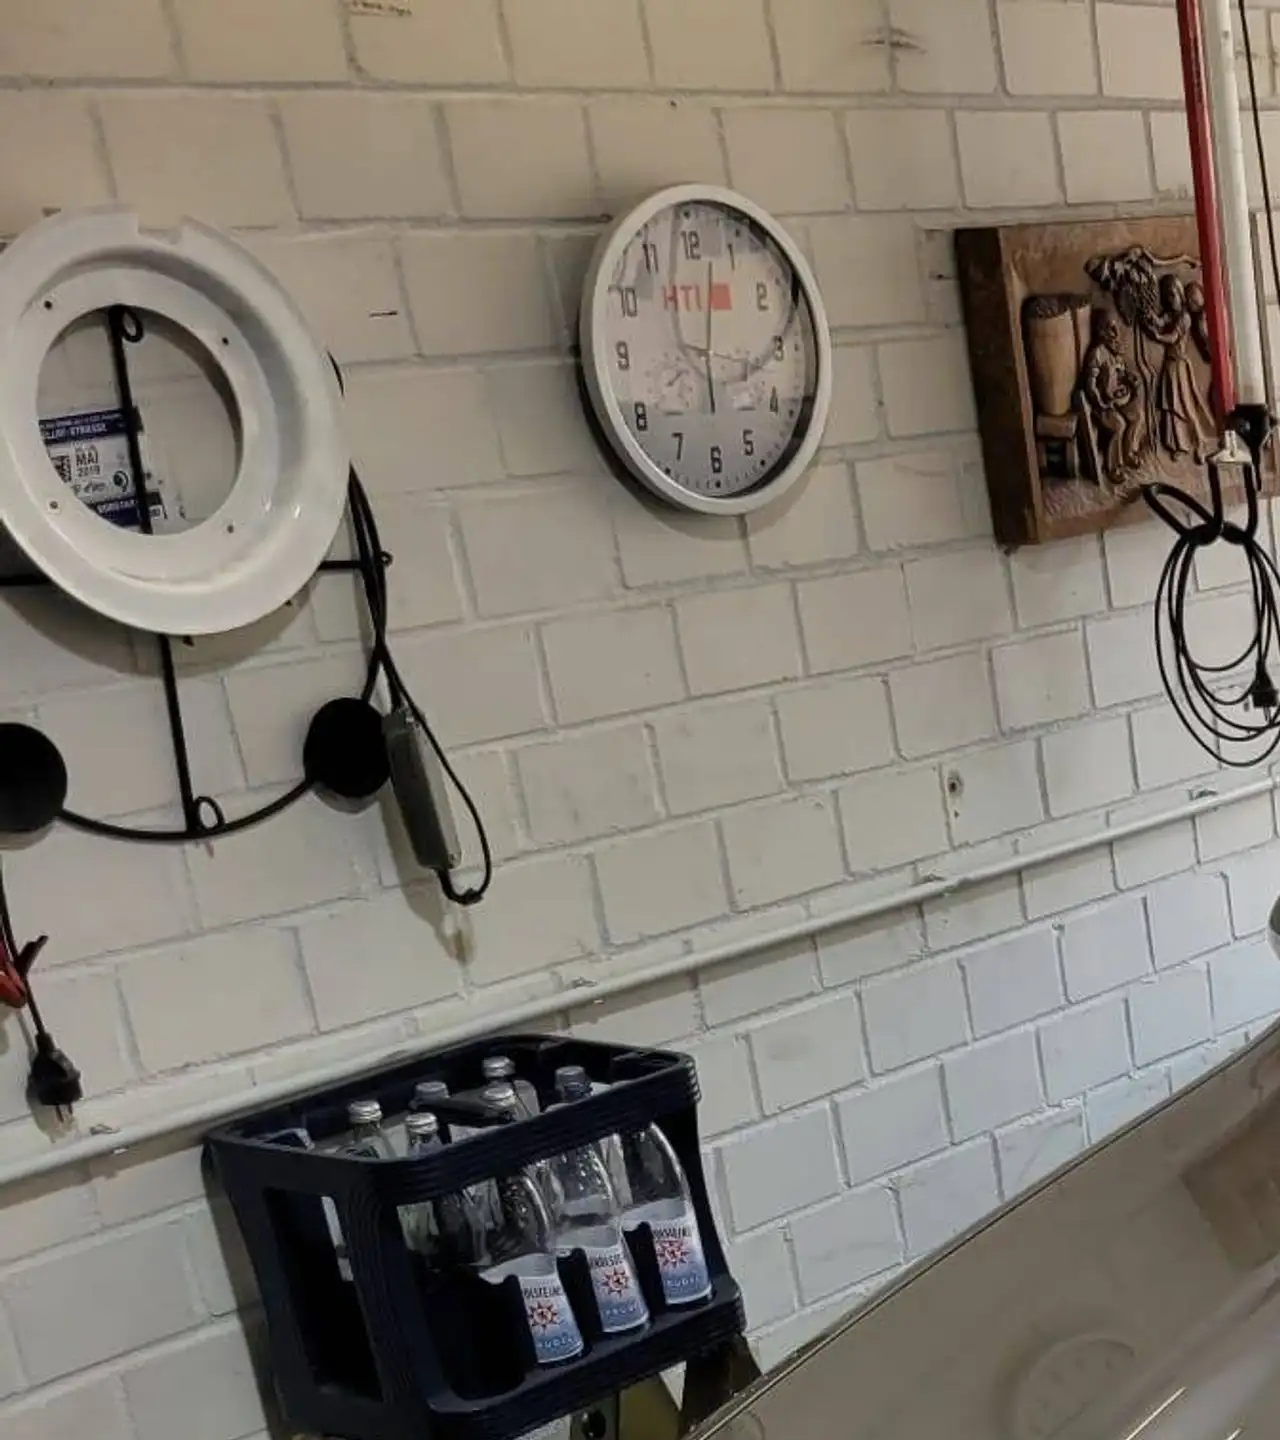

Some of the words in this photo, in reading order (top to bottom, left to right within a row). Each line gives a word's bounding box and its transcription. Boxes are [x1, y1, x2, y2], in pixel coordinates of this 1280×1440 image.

[643, 243, 658, 272] 11
[681, 230, 701, 260] 12
[727, 242, 736, 271] 1
[620, 287, 637, 317] 10
[756, 282, 768, 311] 2
[616, 341, 629, 371] 9
[773, 336, 785, 361] 3
[769, 384, 779, 413] 4
[634, 402, 648, 431] 8
[672, 433, 683, 461] 7
[742, 429, 754, 456] 5
[710, 446, 721, 474] 6
